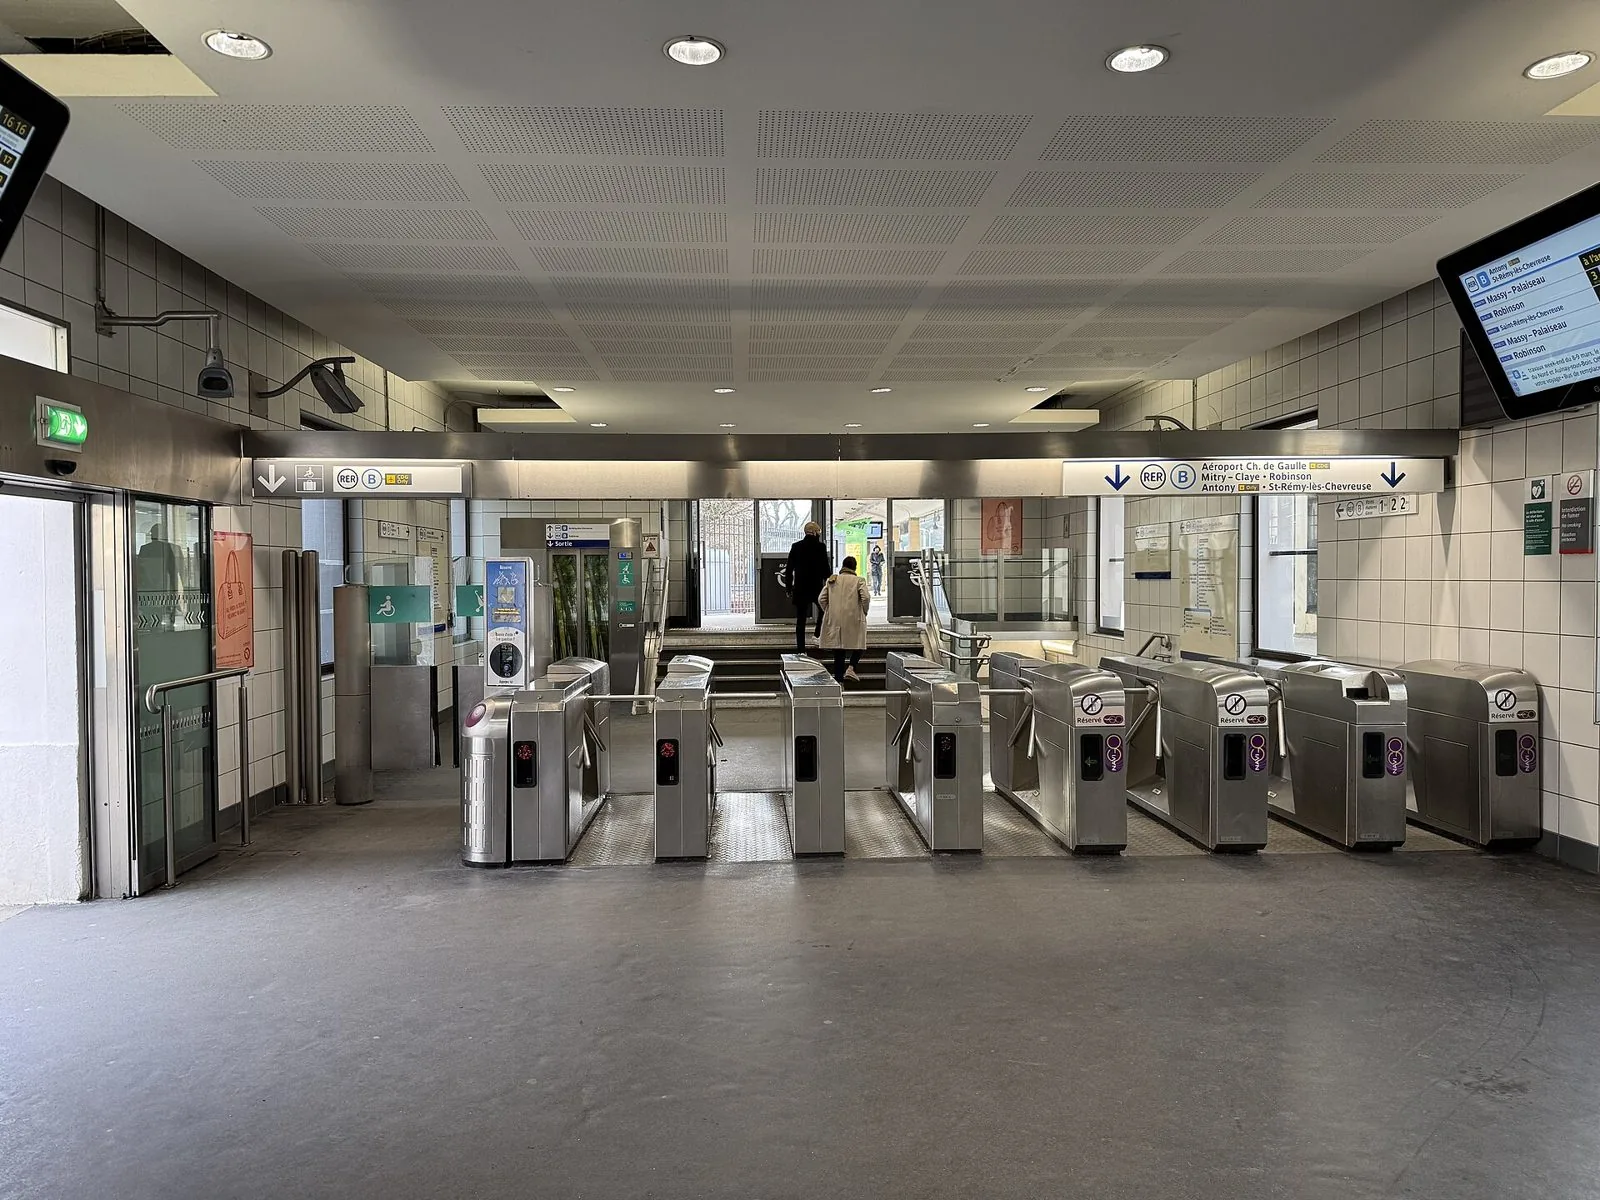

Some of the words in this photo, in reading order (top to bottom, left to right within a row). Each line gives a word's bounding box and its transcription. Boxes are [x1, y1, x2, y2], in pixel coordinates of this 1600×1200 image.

[1583, 257, 1589, 266] à
[1488, 262, 1508, 276] Antony
[1591, 271, 1598, 280] 3
[1486, 291, 1508, 305] Massy
[1511, 275, 1546, 294] Palaiseau
[1492, 301, 1525, 318] Robinson
[1506, 333, 1528, 346] Massy
[1532, 321, 1567, 337] Palaiseau
[1513, 344, 1546, 360] Robinson
[1201, 462, 1243, 474] Aéroport
[1246, 462, 1261, 471] Ch.
[1263, 461, 1275, 471] de
[1277, 461, 1307, 471] Gaulle
[340, 474, 356, 483] RER
[368, 474, 376, 484] B
[1143, 471, 1163, 482] RER
[1178, 470, 1188, 483] B
[1201, 473, 1227, 483] Mitry
[1235, 472, 1260, 483] Claye
[1269, 472, 1312, 481] Robinson
[1201, 484, 1236, 493] Antony
[1268, 482, 1372, 493] St-Rémy-lès-Chevreuse
[1076, 716, 1102, 724] Réservé
[1220, 716, 1245, 724] Réservé
